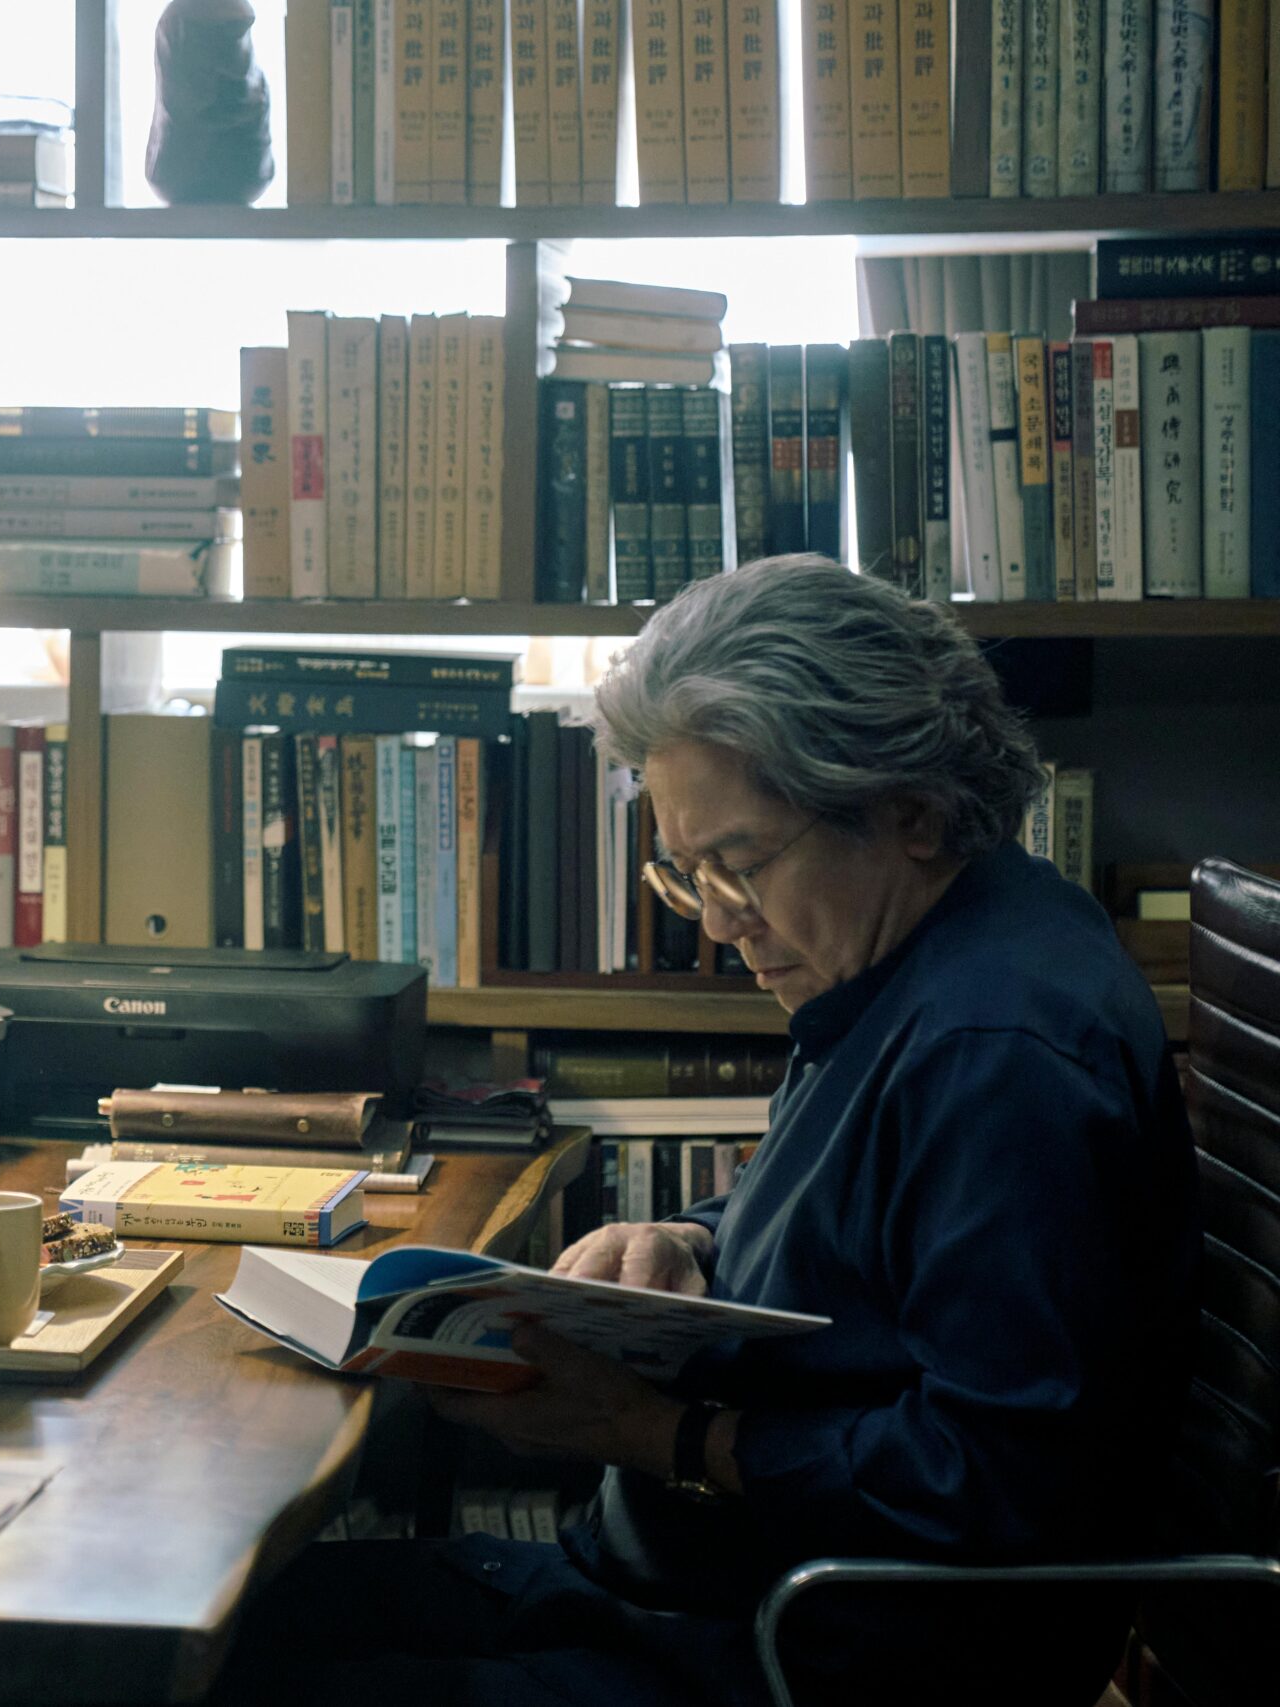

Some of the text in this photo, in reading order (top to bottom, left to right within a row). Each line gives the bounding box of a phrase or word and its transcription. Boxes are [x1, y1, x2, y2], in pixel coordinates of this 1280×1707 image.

[1035, 76, 1047, 91] 2
[1075, 69, 1088, 84] 3
[103, 996, 167, 1015] Canon
